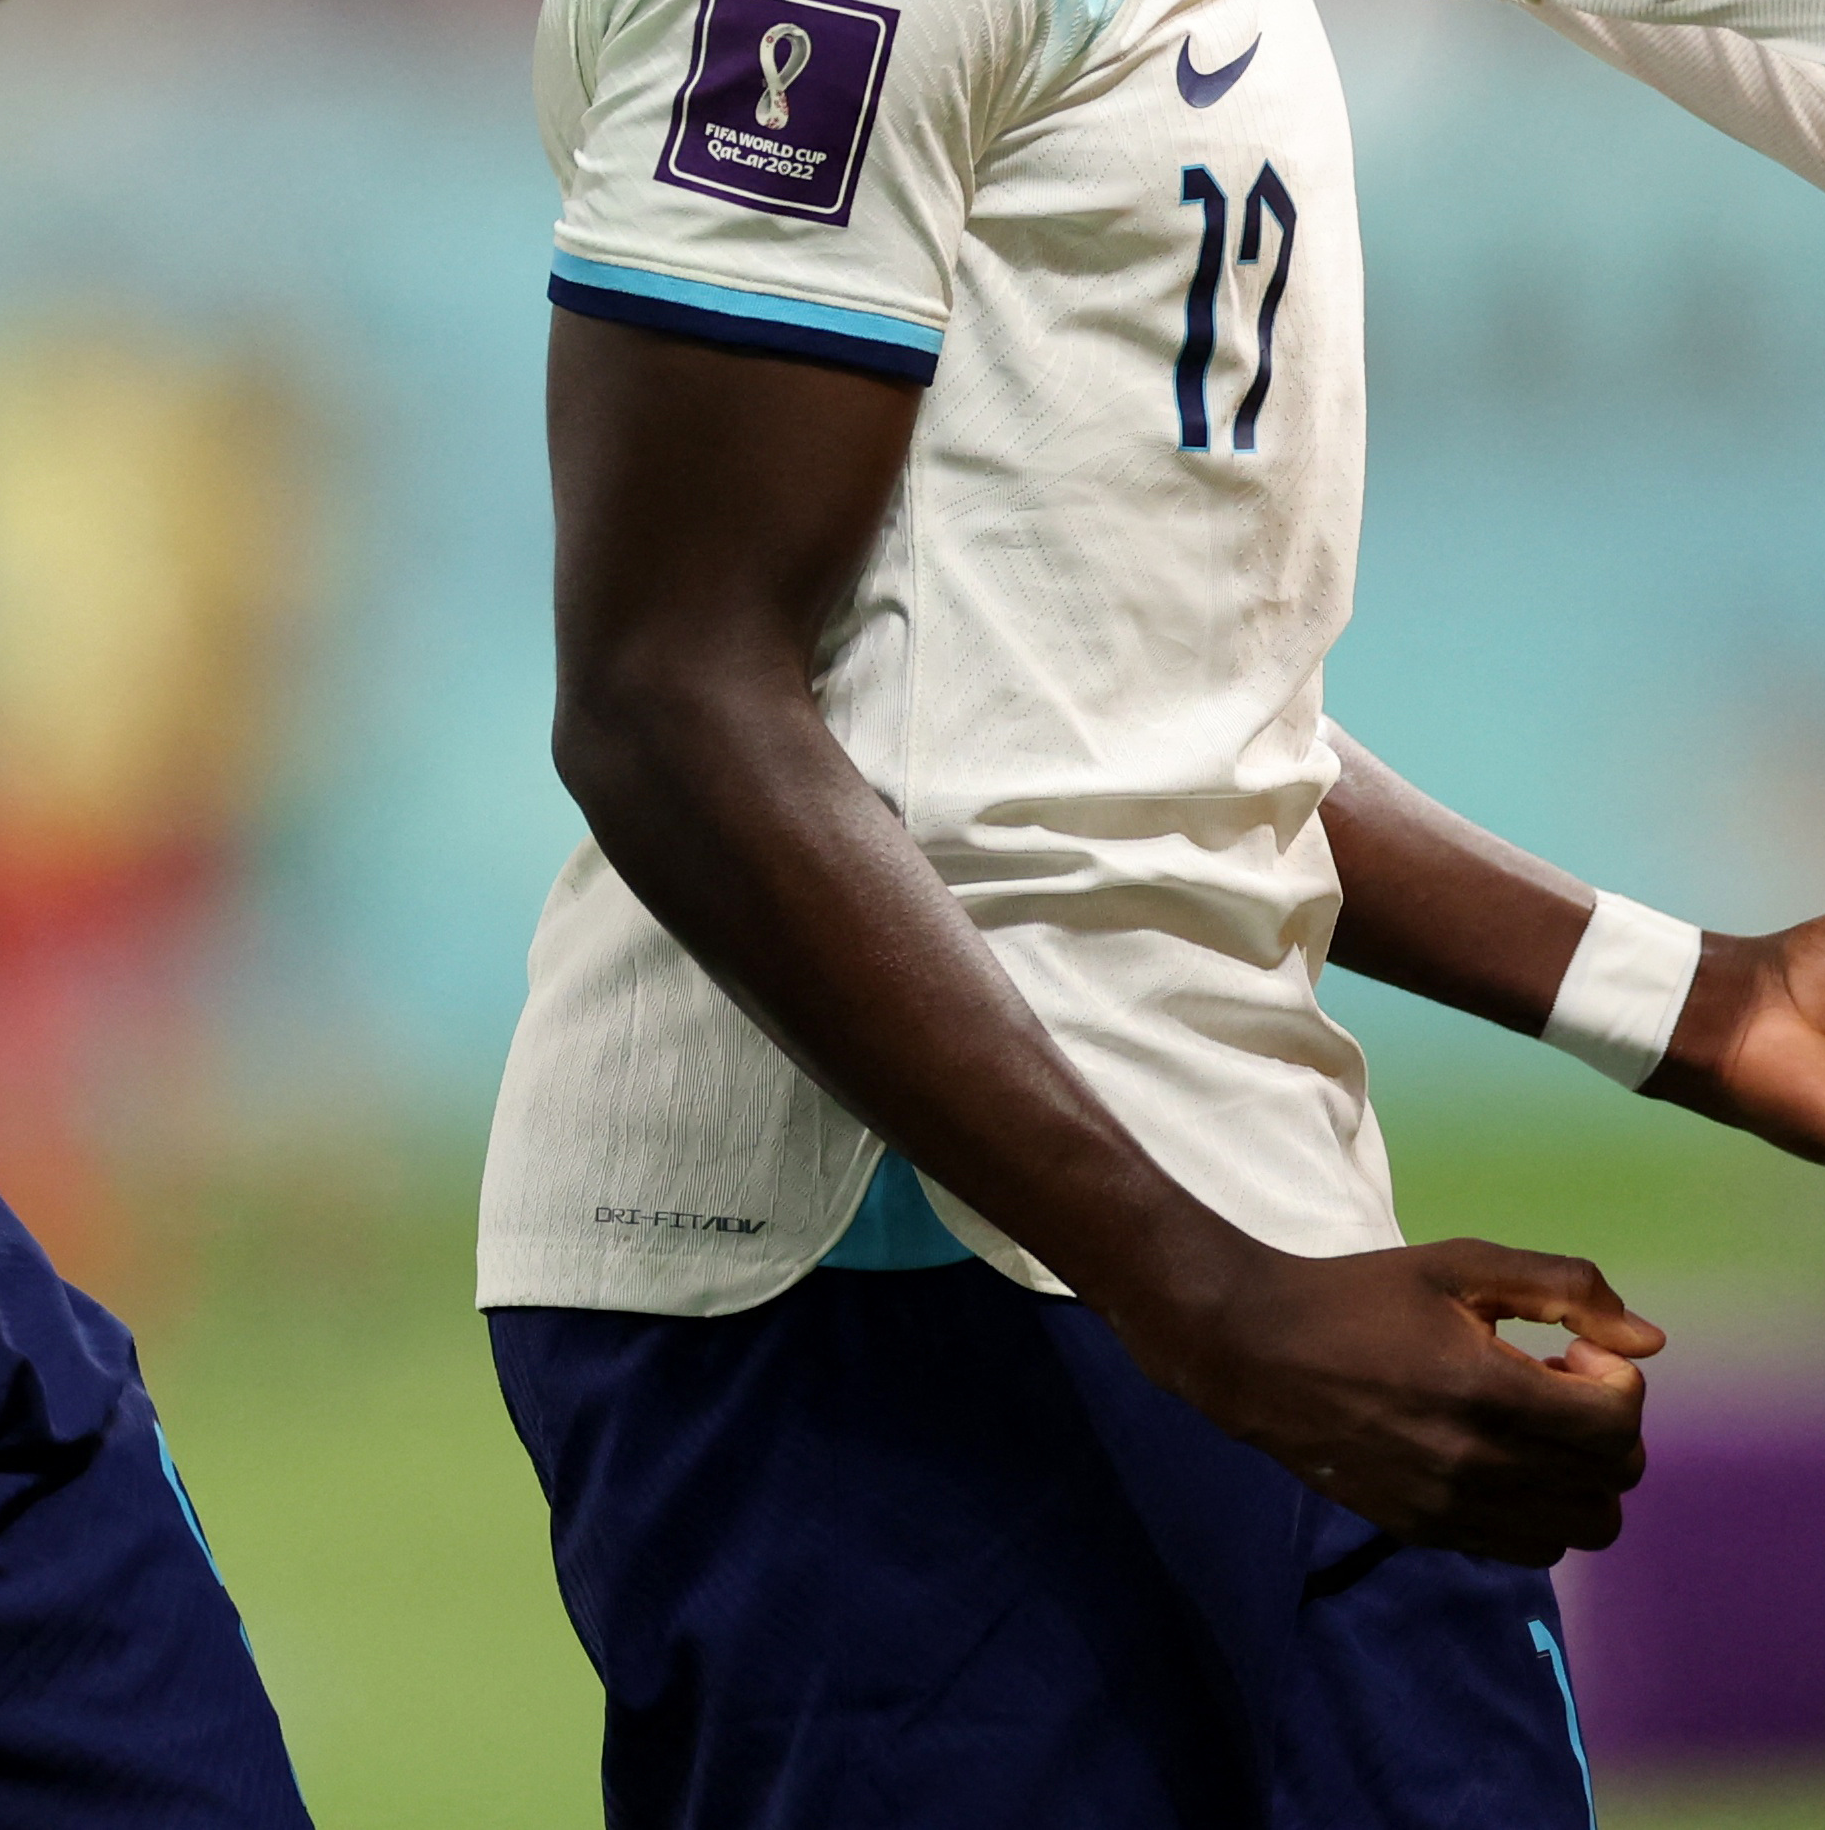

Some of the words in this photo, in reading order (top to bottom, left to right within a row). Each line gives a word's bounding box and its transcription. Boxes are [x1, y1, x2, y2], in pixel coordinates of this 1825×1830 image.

[705, 122, 737, 145] FIFA
[739, 131, 794, 159] WORLD
[794, 147, 827, 166] CUP
[707, 139, 815, 181] Qatar2022
[1172, 157, 1298, 454] 17
